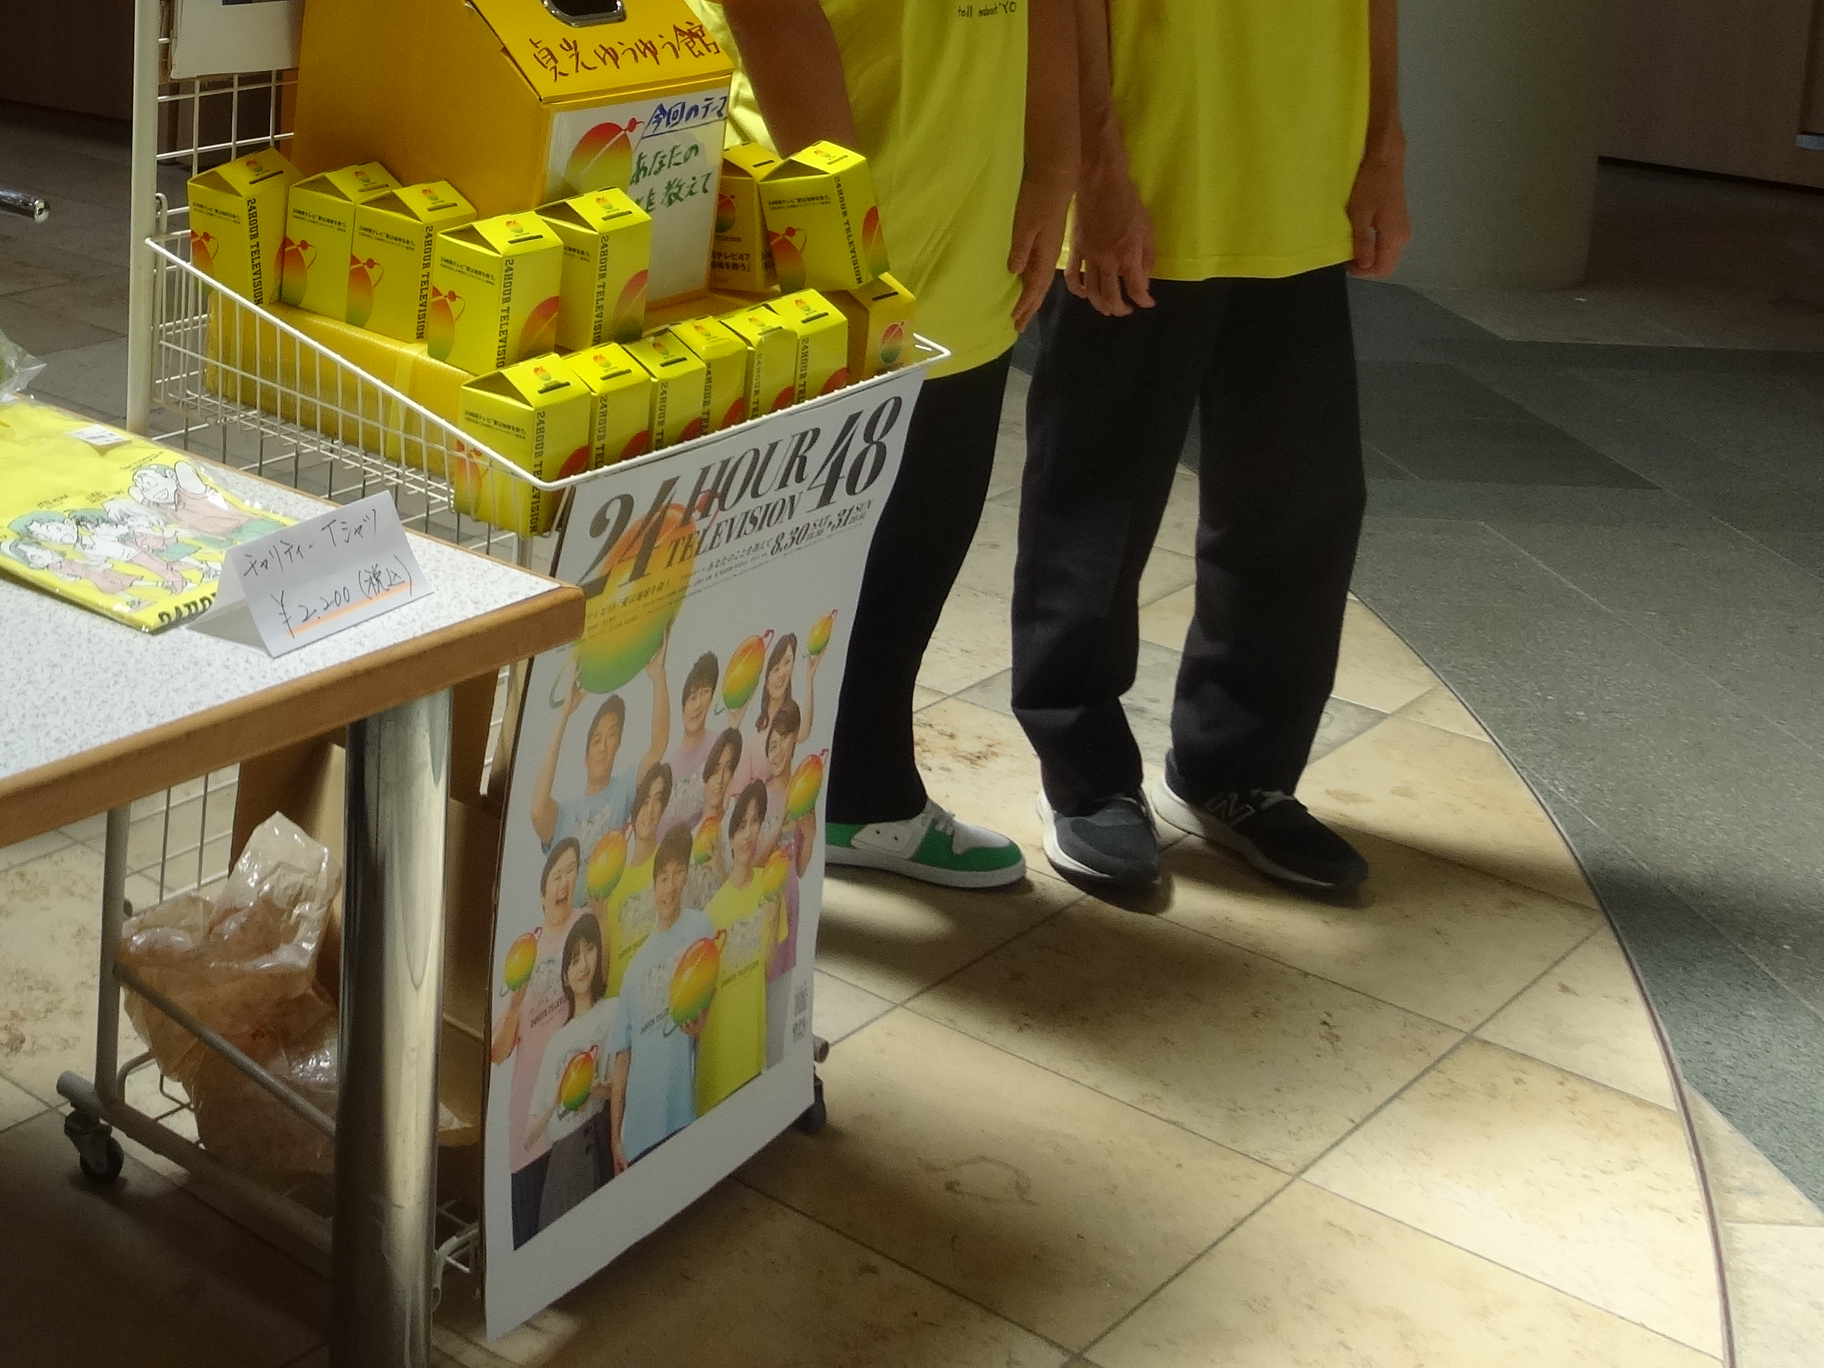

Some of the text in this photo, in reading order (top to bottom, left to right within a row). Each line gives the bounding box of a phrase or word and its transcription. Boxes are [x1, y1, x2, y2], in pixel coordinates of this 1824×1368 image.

[247, 197, 264, 305] 24HOUR TELEVISION
[598, 236, 609, 283] 24HOUR
[415, 225, 434, 340] 24HOUR TELEVISION
[502, 259, 515, 304] 24HOUR
[596, 396, 608, 442] 24HOUR
[658, 381, 669, 425] 24HOUR
[533, 411, 546, 457] 24HOUR
[578, 396, 903, 598] 24 HOUR 48
[664, 491, 804, 569] TELEVISION
